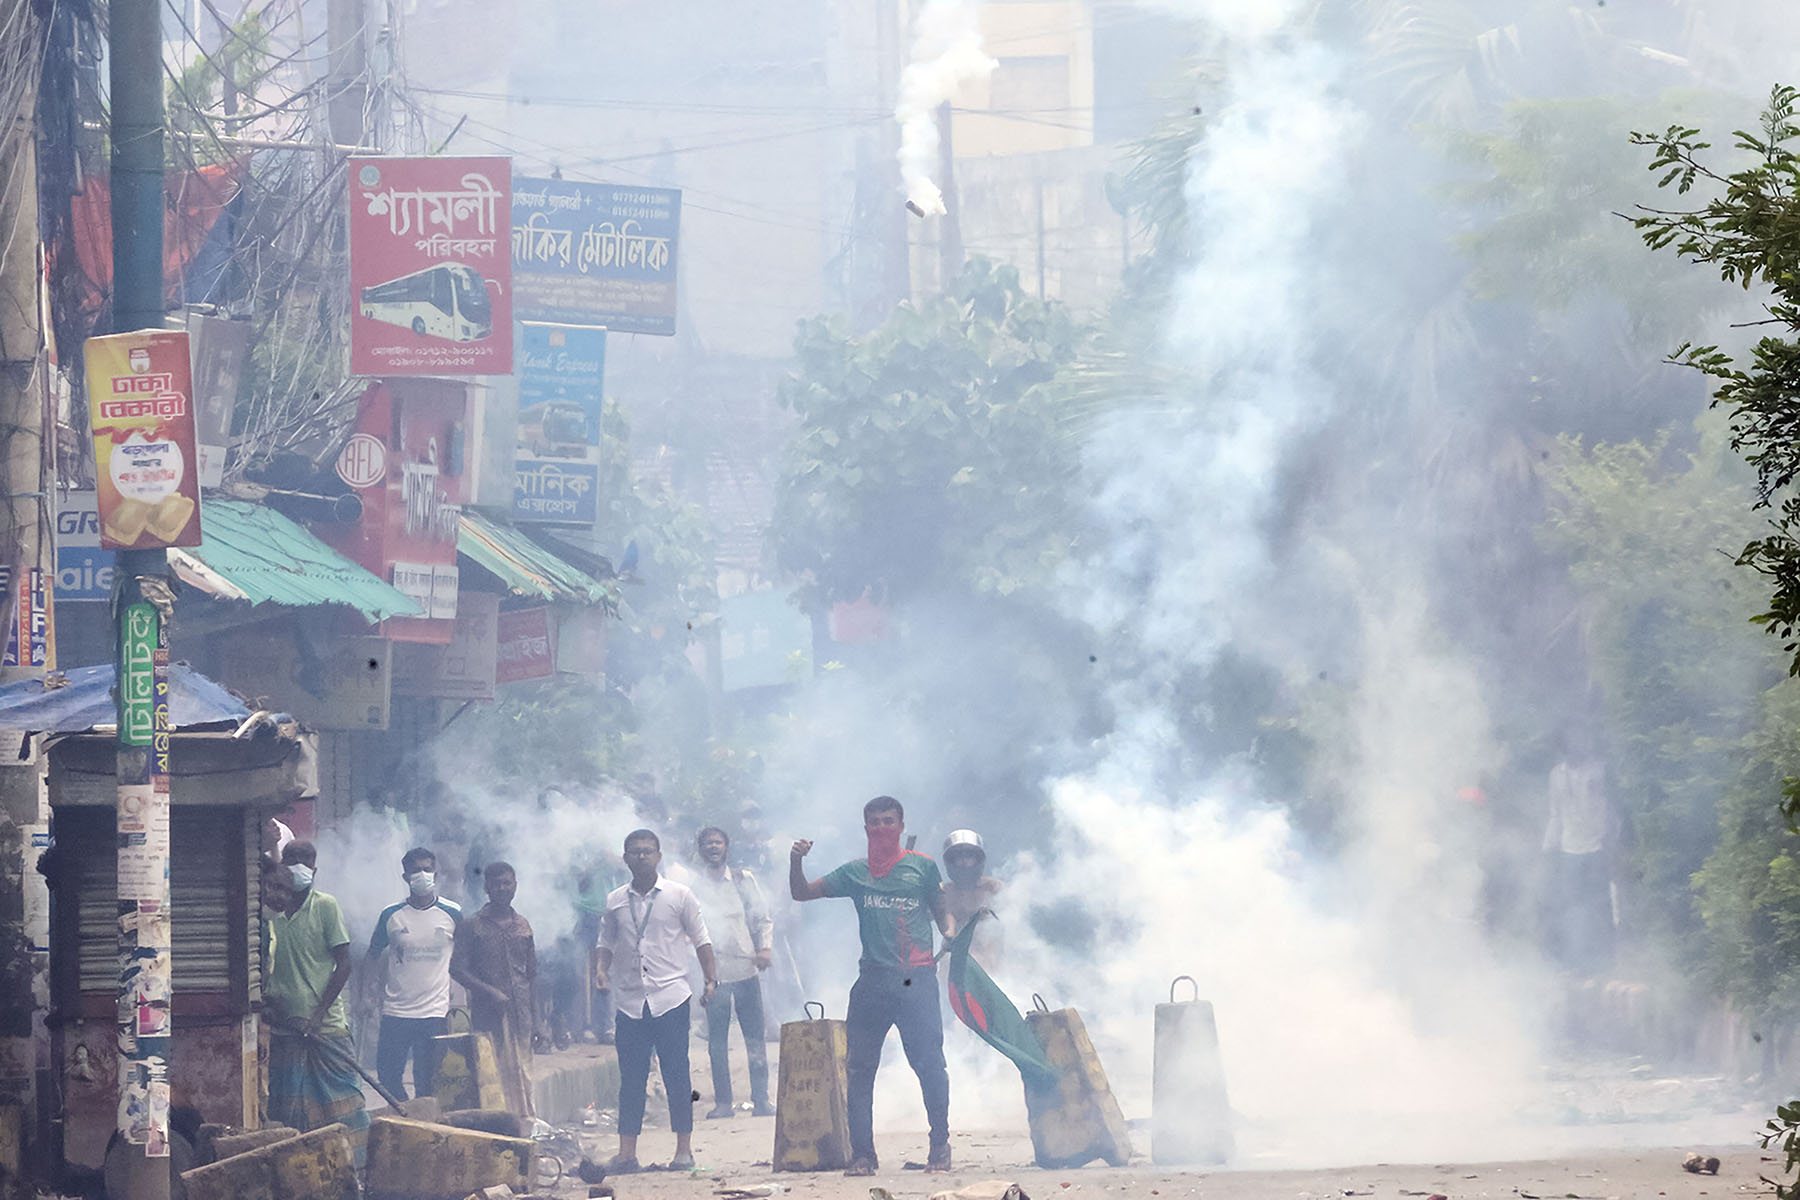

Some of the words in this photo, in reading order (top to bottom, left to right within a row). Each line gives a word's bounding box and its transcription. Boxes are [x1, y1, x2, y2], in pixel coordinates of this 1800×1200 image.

[362, 172, 503, 235] শ্যামলী
[415, 233, 496, 258] পরিবহন
[577, 219, 671, 273] মেটালিক
[111, 373, 172, 394] ঢাকা
[100, 391, 186, 420] বেকারী
[515, 463, 593, 497] মানিক
